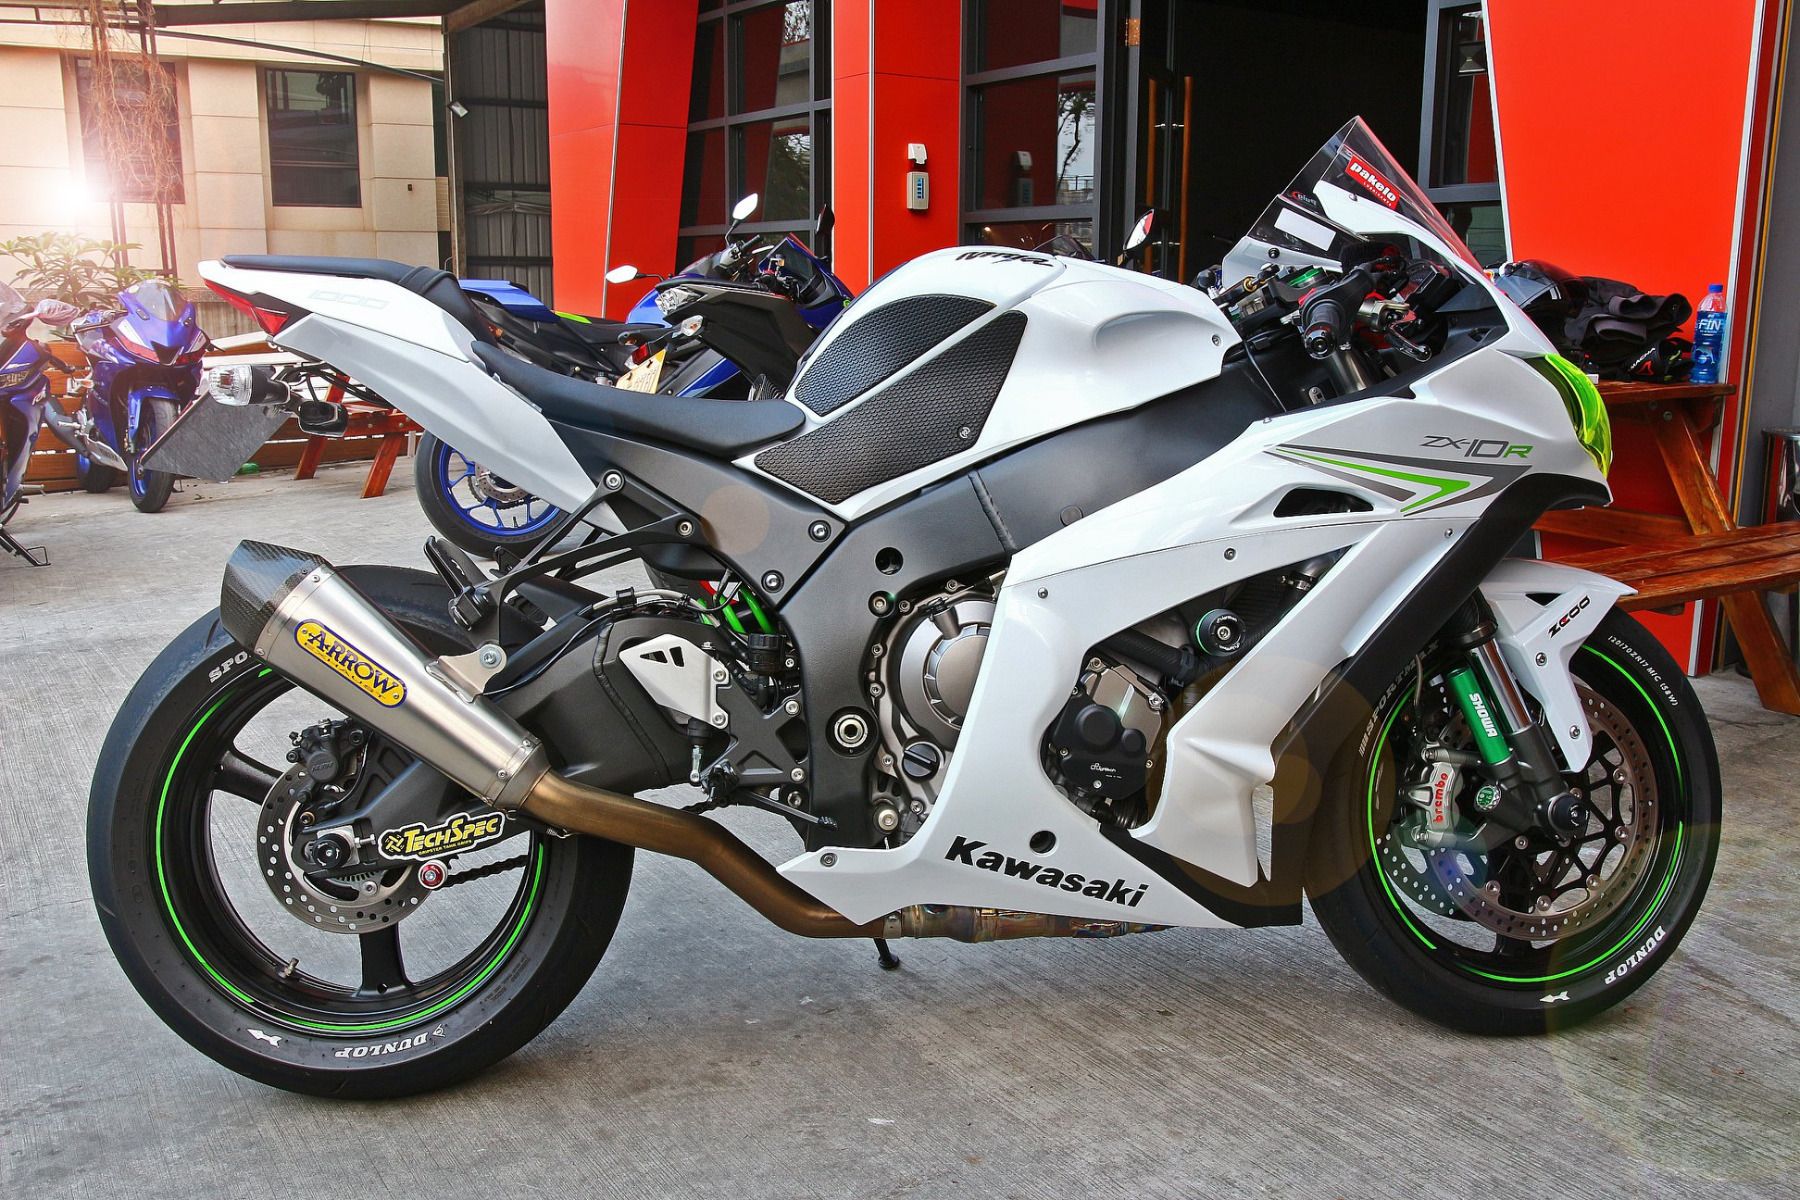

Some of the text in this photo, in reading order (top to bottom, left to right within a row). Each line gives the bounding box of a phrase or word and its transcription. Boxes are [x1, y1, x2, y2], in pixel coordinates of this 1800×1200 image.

[1350, 162, 1397, 202] pakelo
[955, 251, 1054, 267] Ninja
[1420, 435, 1534, 458] ZX-10R
[208, 651, 250, 683] SPO
[307, 630, 399, 694] ARROW
[1469, 692, 1498, 738] SHOWA
[1433, 772, 1448, 823] brembo
[944, 835, 1149, 908] Kawasaki
[1604, 925, 1666, 985] DUNLOP
[334, 1032, 429, 1058] DUNLOP
